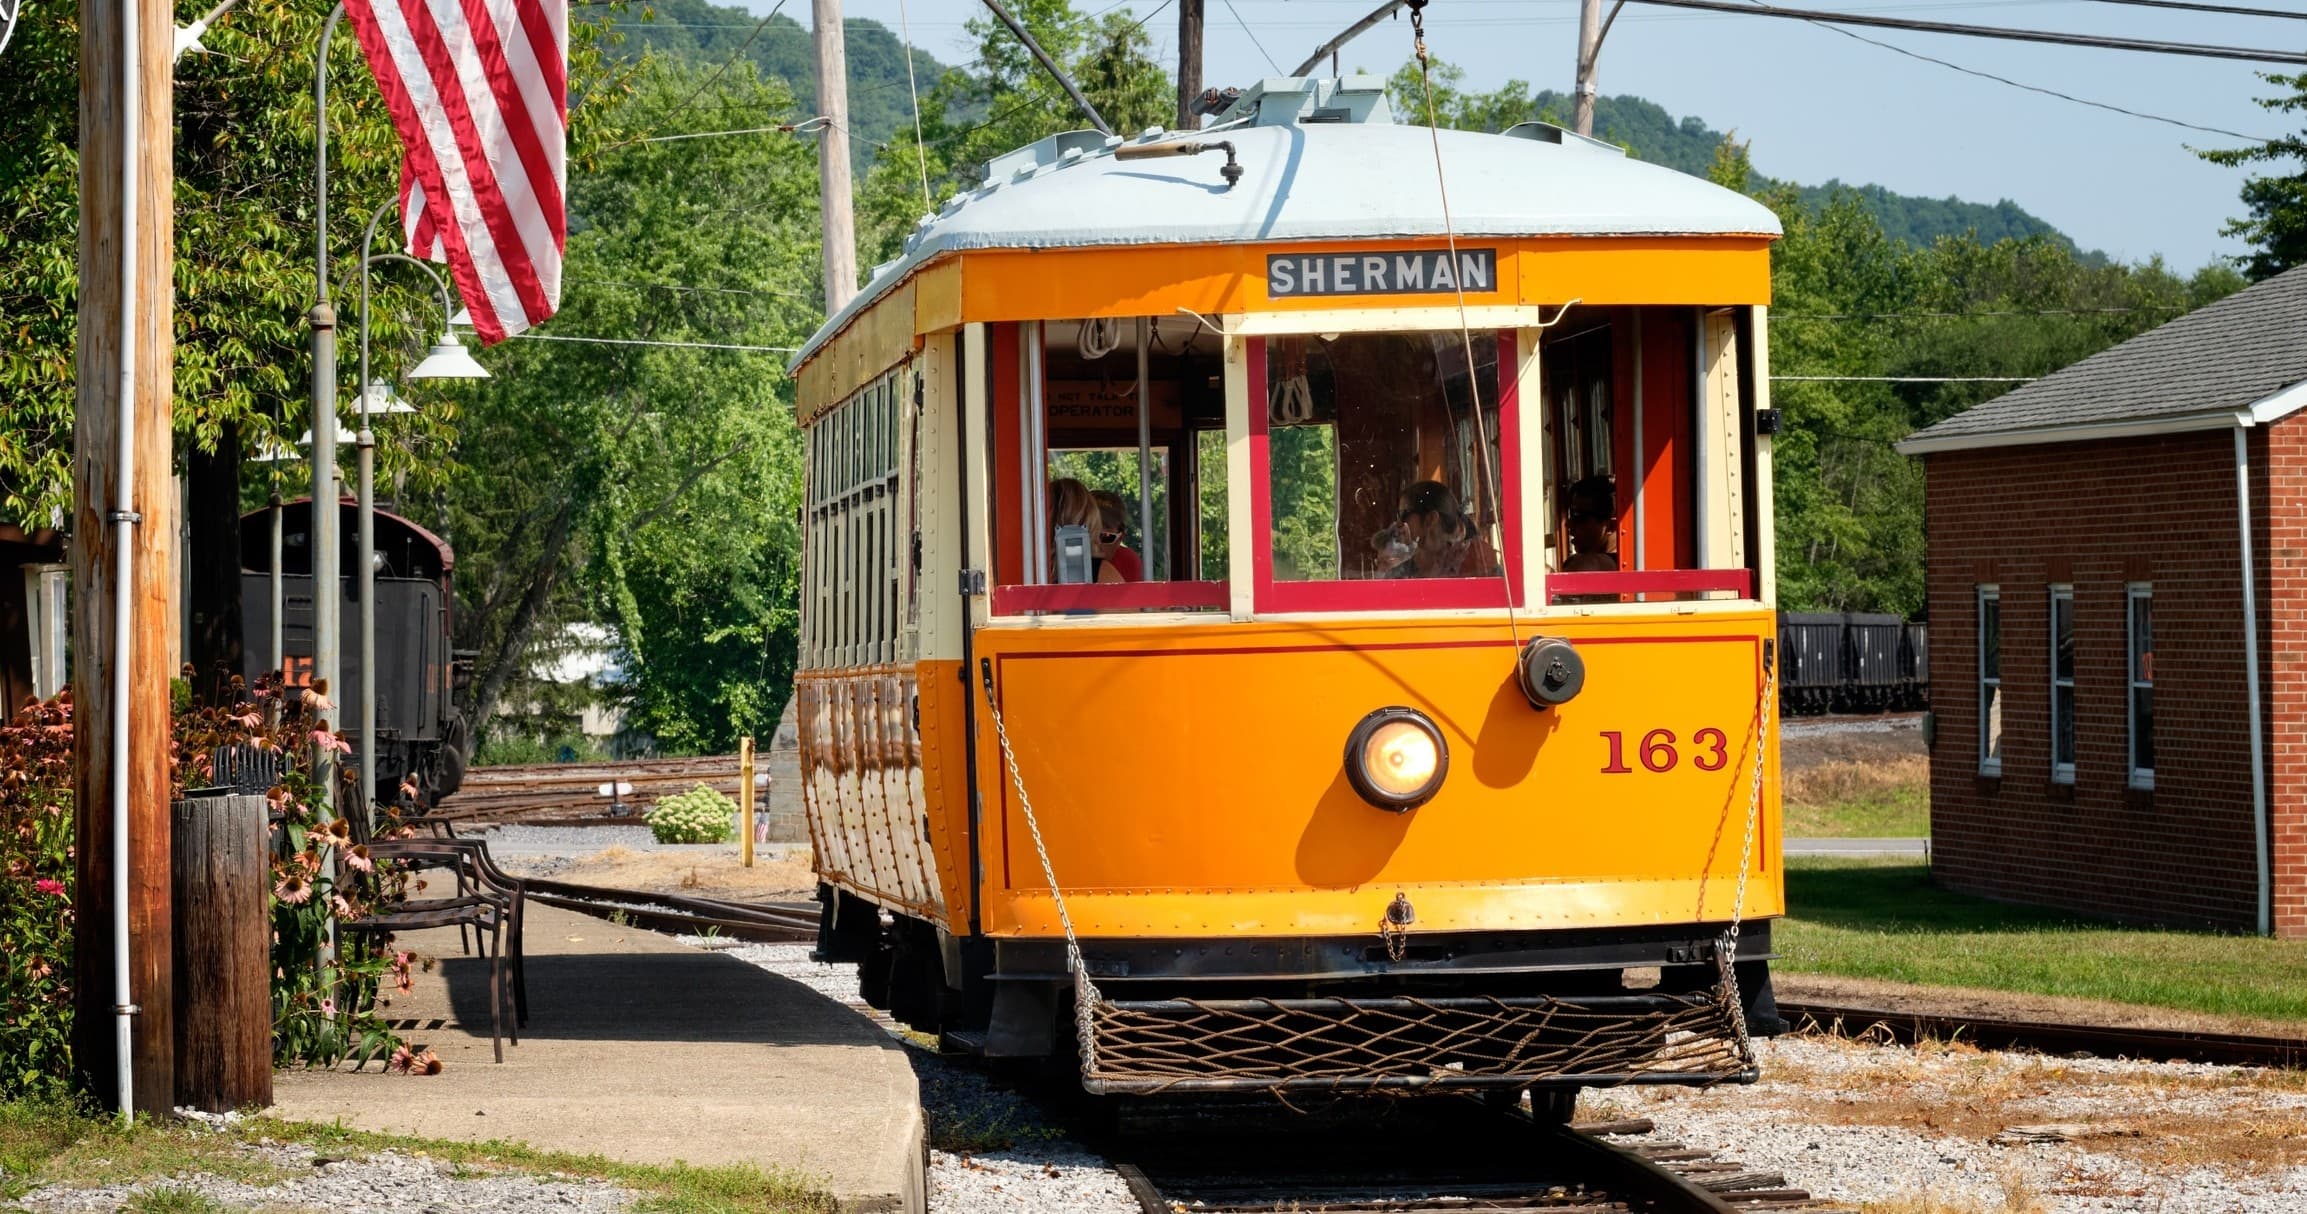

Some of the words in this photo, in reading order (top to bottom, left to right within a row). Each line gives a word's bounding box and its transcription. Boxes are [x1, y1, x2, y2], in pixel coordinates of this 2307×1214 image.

[1270, 254, 1487, 293] SHERMAN
[1049, 405, 1134, 417] OPERATOR
[1600, 728, 1728, 773] 163
